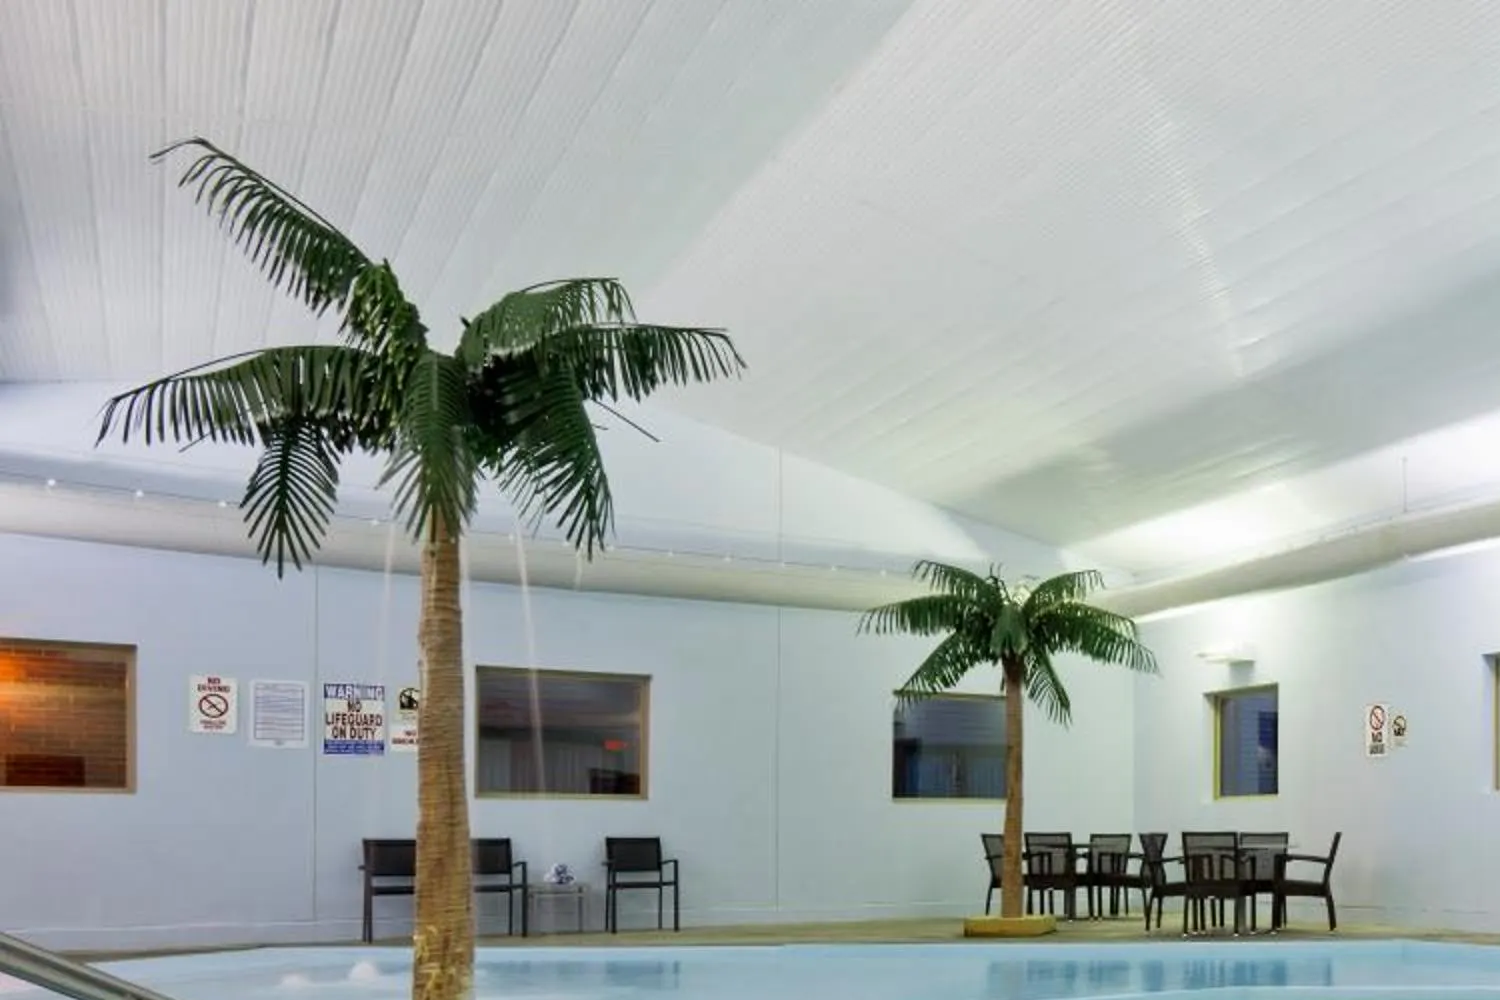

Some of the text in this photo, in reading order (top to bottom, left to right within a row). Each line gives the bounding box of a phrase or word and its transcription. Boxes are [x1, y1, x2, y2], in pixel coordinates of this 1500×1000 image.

[347, 700, 362, 712] NO
[325, 713, 383, 726] LIFEGUARD
[331, 726, 377, 739] ON DUTY
